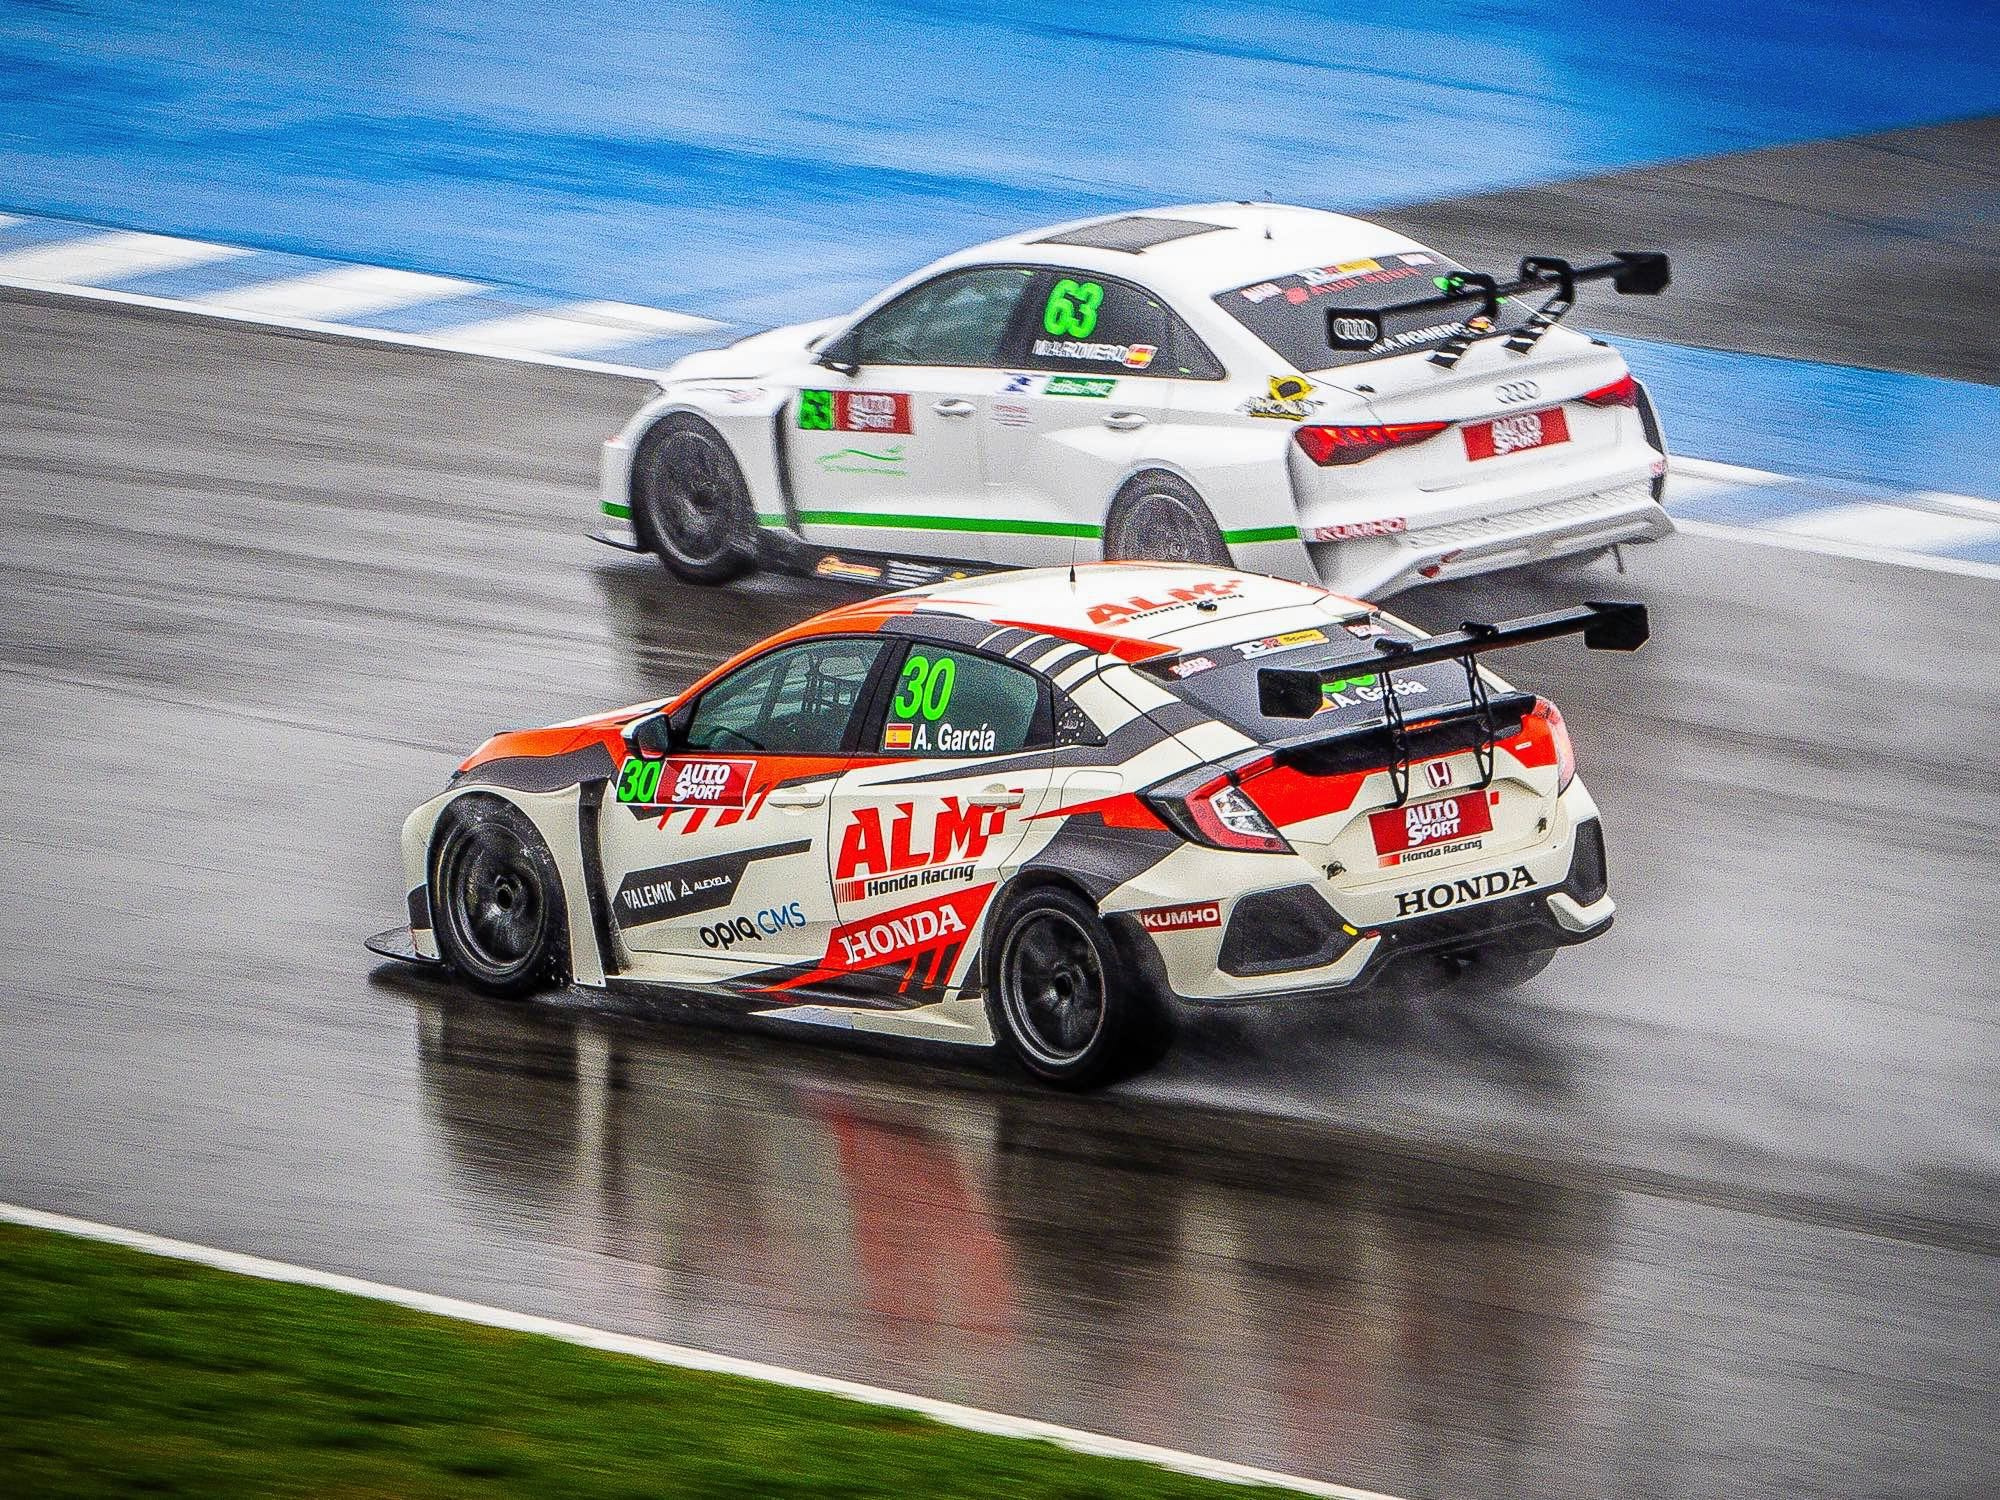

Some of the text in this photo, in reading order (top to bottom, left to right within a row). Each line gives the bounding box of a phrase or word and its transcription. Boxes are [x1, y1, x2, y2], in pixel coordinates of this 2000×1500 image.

[1044, 279, 1104, 338] 63
[1086, 583, 1235, 625] ALM
[894, 655, 955, 721] 30
[1331, 692, 1361, 708] A.
[913, 722, 996, 752] A. García
[617, 760, 661, 803] 30
[676, 763, 731, 785] AUTO
[672, 780, 724, 802] SPORT
[1405, 800, 1460, 829] AUTO
[836, 796, 990, 880] ALM
[1407, 818, 1461, 848] SPORT
[1402, 839, 1482, 863] Honda Racing
[694, 875, 733, 892] ALEXELA
[866, 864, 976, 897] Honda Racing
[1394, 865, 1538, 918] HONDA
[757, 901, 807, 934] CMS
[1144, 907, 1218, 928] KUMHO
[838, 904, 966, 965] HONDA
